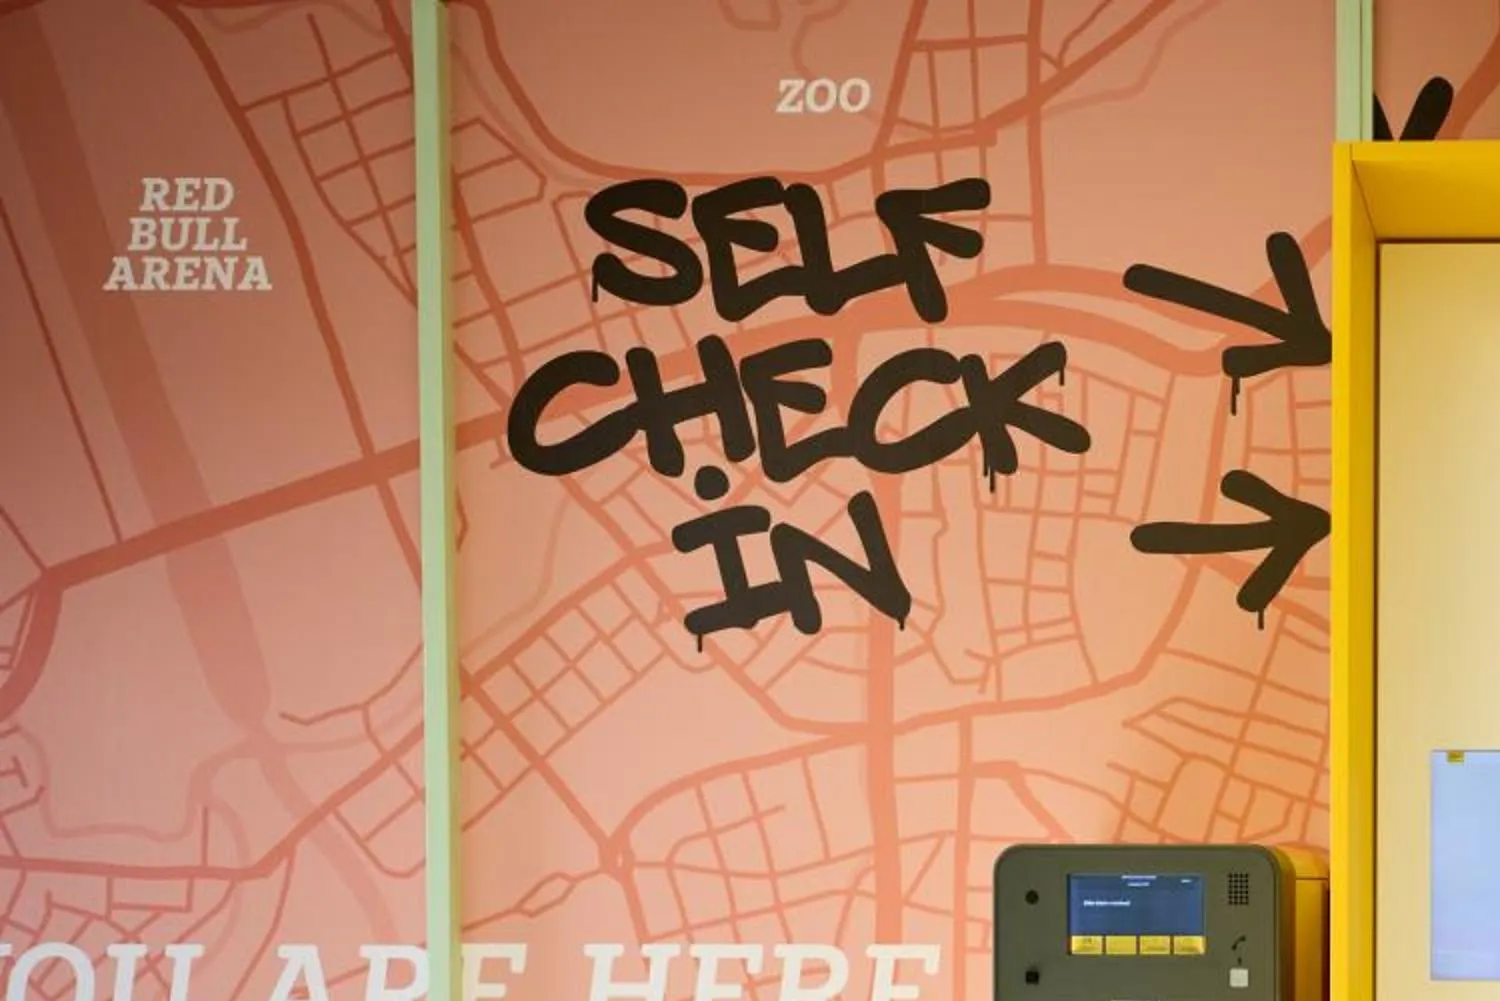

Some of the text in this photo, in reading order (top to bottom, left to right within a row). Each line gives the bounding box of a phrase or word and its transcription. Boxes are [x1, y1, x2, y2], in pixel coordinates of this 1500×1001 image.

[775, 78, 871, 113] ZOO
[139, 176, 234, 212] RED
[127, 217, 248, 252] BULL
[584, 175, 991, 323] SELF
[102, 256, 273, 291] ARENA
[507, 334, 1092, 494] CHECK
[671, 463, 912, 654] IN
